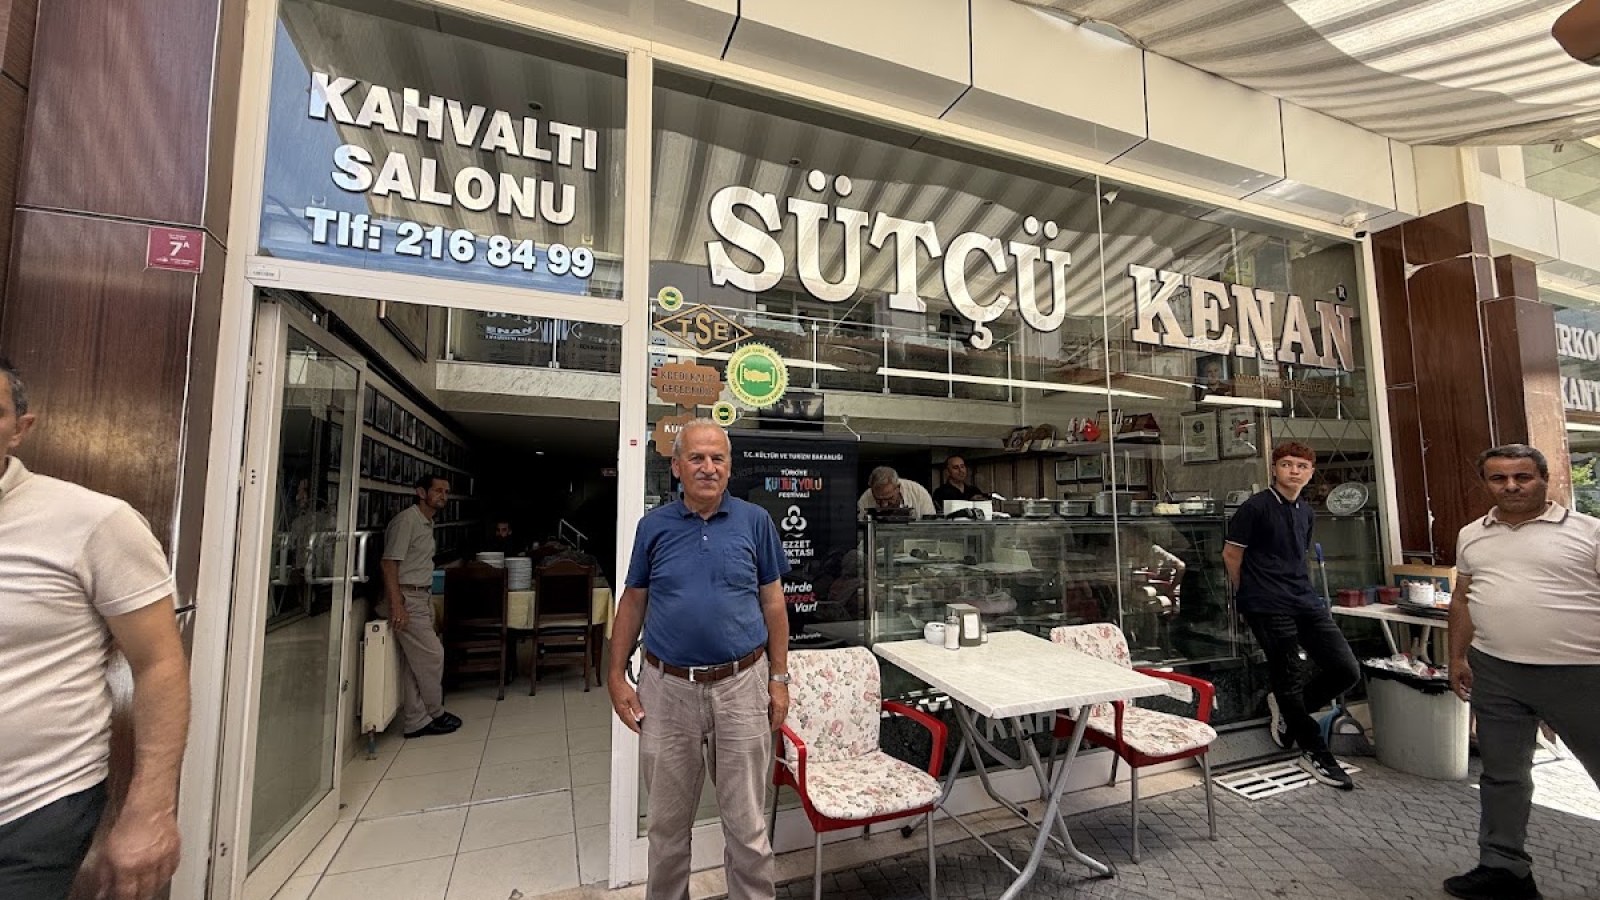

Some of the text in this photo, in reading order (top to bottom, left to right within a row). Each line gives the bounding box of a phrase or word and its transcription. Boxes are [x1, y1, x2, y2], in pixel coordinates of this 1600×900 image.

[308, 71, 598, 172] KAHVALTI
[330, 144, 577, 225] SALONU
[304, 206, 595, 280] Tlf: 216 84 99
[706, 169, 1072, 350] SÜTÇÜ
[1128, 264, 1356, 372] KENAN
[676, 312, 729, 345] TSE
[780, 452, 788, 460] VE
[799, 477, 822, 491] YOLU
[782, 540, 811, 548] EZZET
